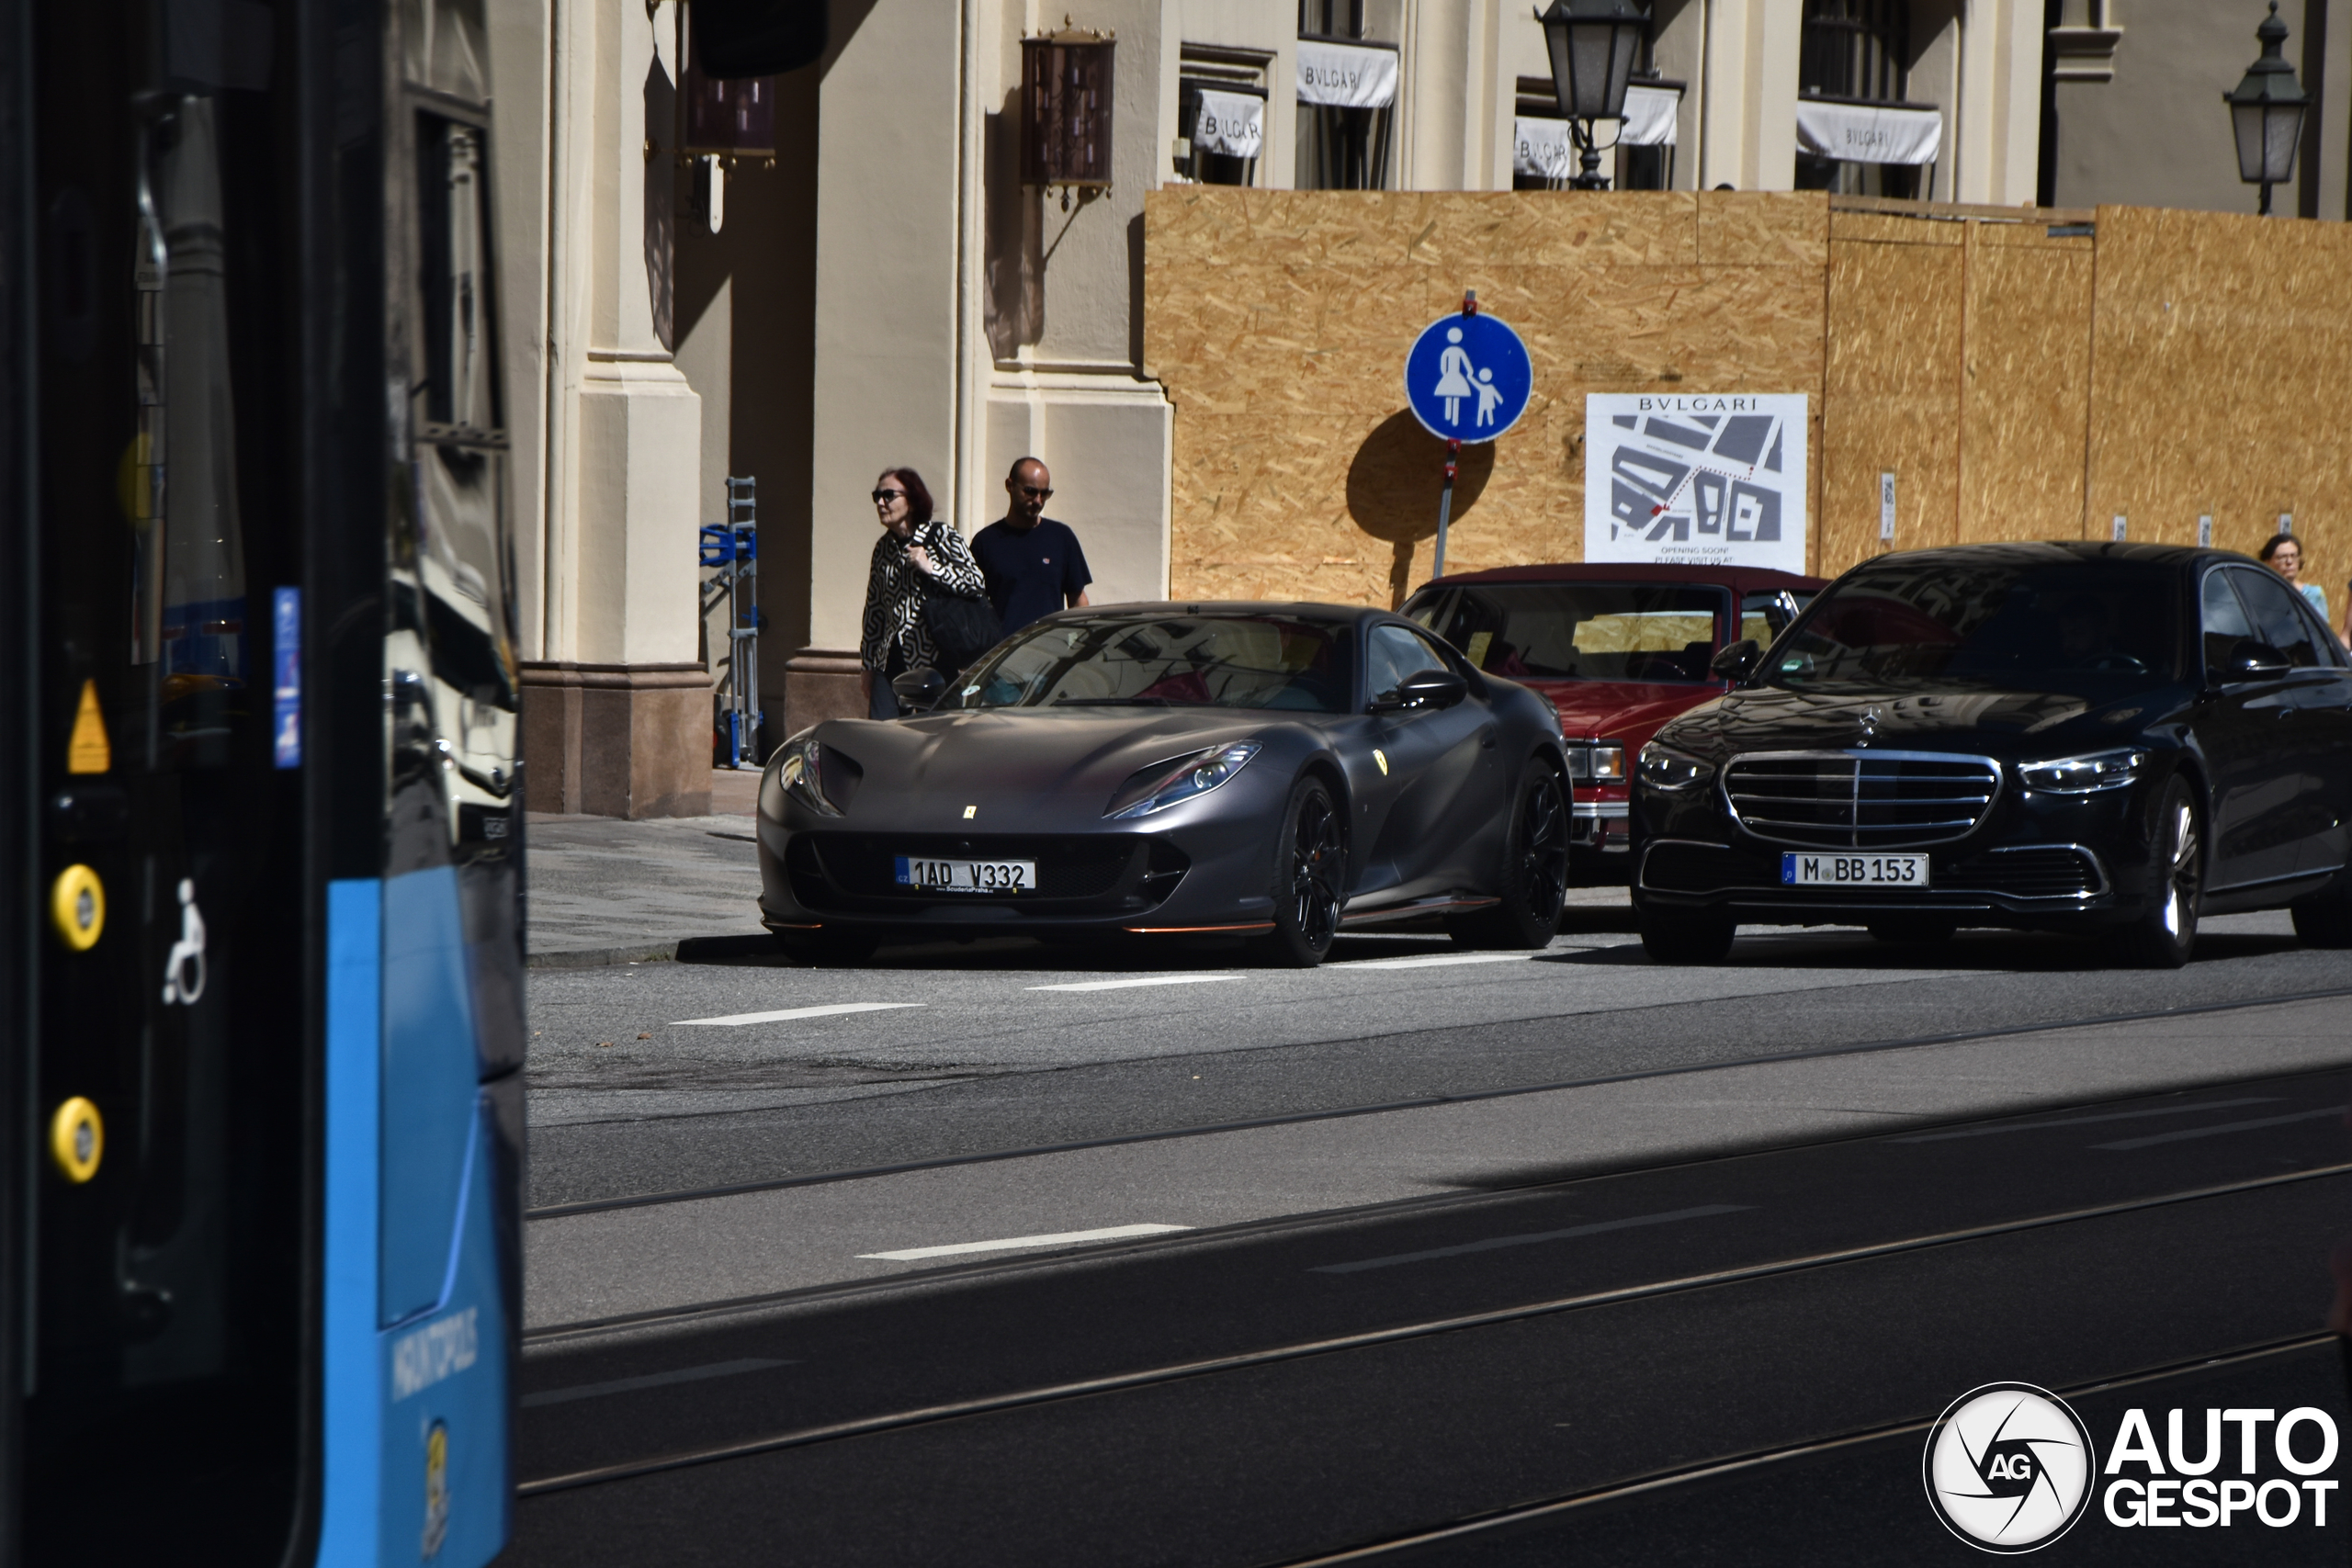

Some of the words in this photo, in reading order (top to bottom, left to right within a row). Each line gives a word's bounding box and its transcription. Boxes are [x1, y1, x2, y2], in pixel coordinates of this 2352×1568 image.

[1639, 398, 1756, 411] BVLGARI
[1661, 547, 1700, 555] OPENING
[915, 862, 952, 885] 1AD
[970, 863, 1024, 886] V332
[1804, 858, 1819, 881] M
[1836, 859, 1866, 881] BB
[1871, 859, 1916, 882] 153
